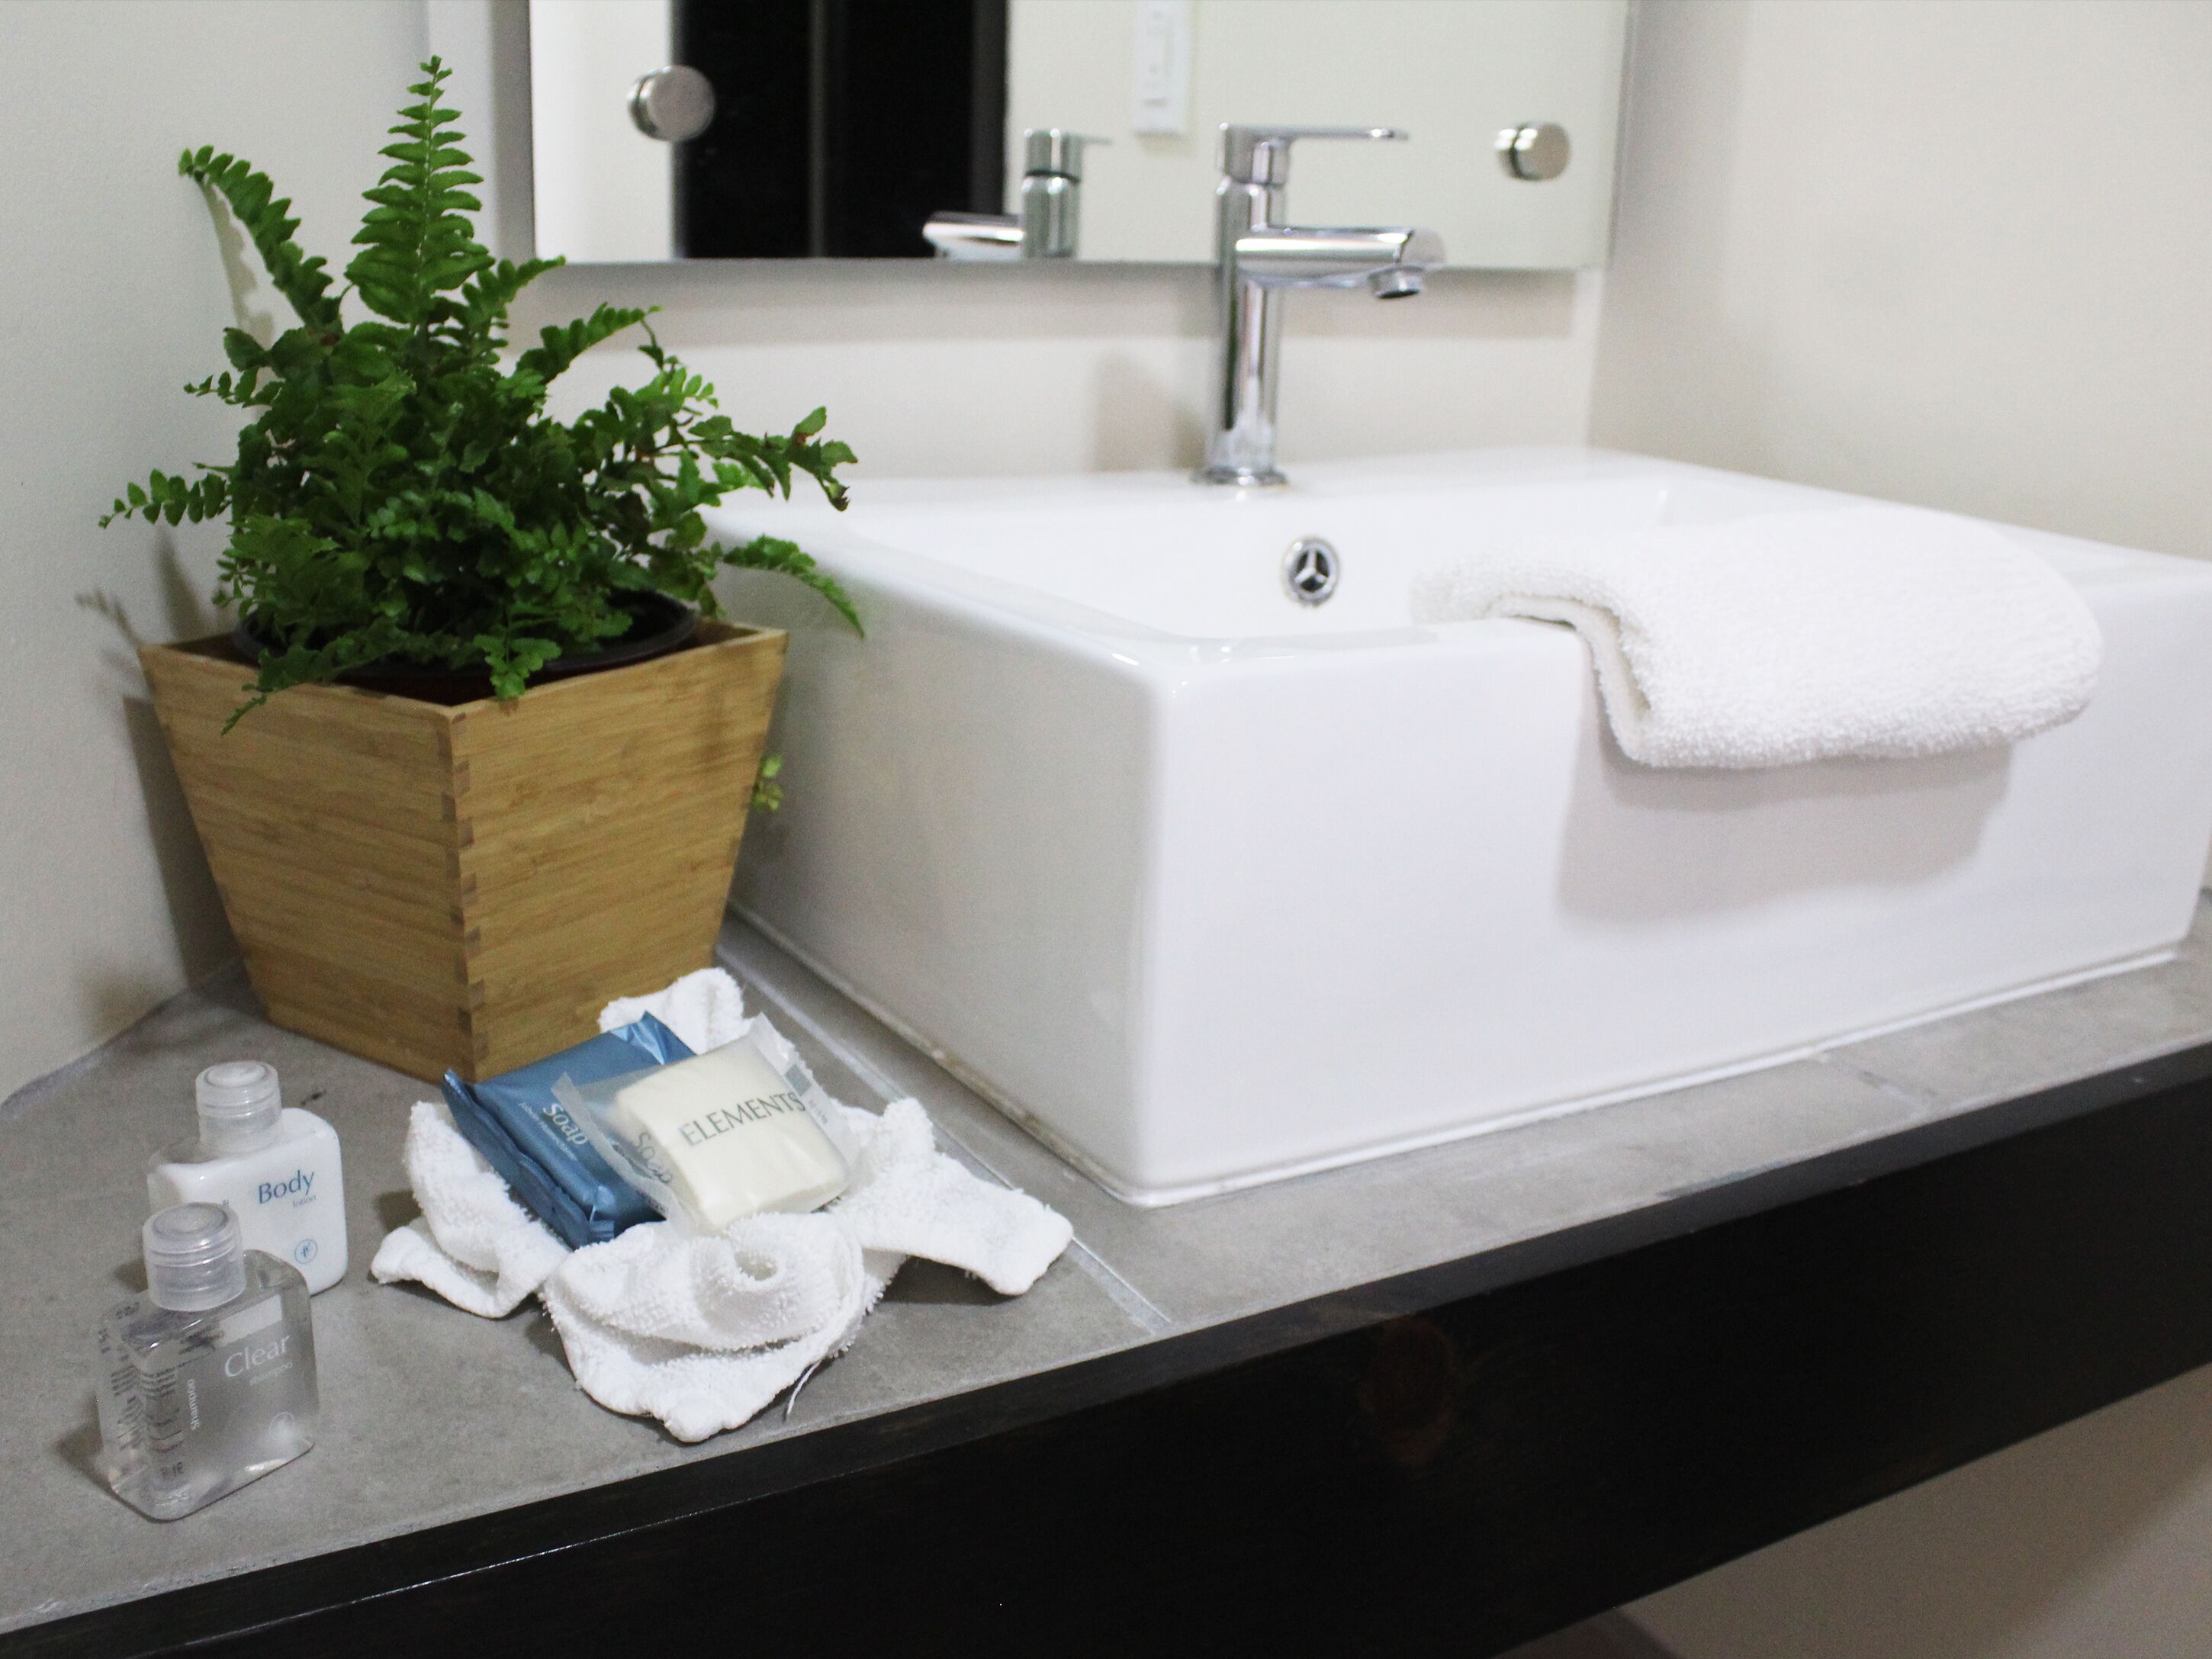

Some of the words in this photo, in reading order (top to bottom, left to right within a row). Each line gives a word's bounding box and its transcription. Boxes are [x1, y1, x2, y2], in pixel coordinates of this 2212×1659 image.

[542, 1103, 587, 1144] Soap
[680, 1092, 805, 1146] ELEMENTS
[258, 1170, 314, 1204] Body
[225, 1336, 290, 1378] Clear
